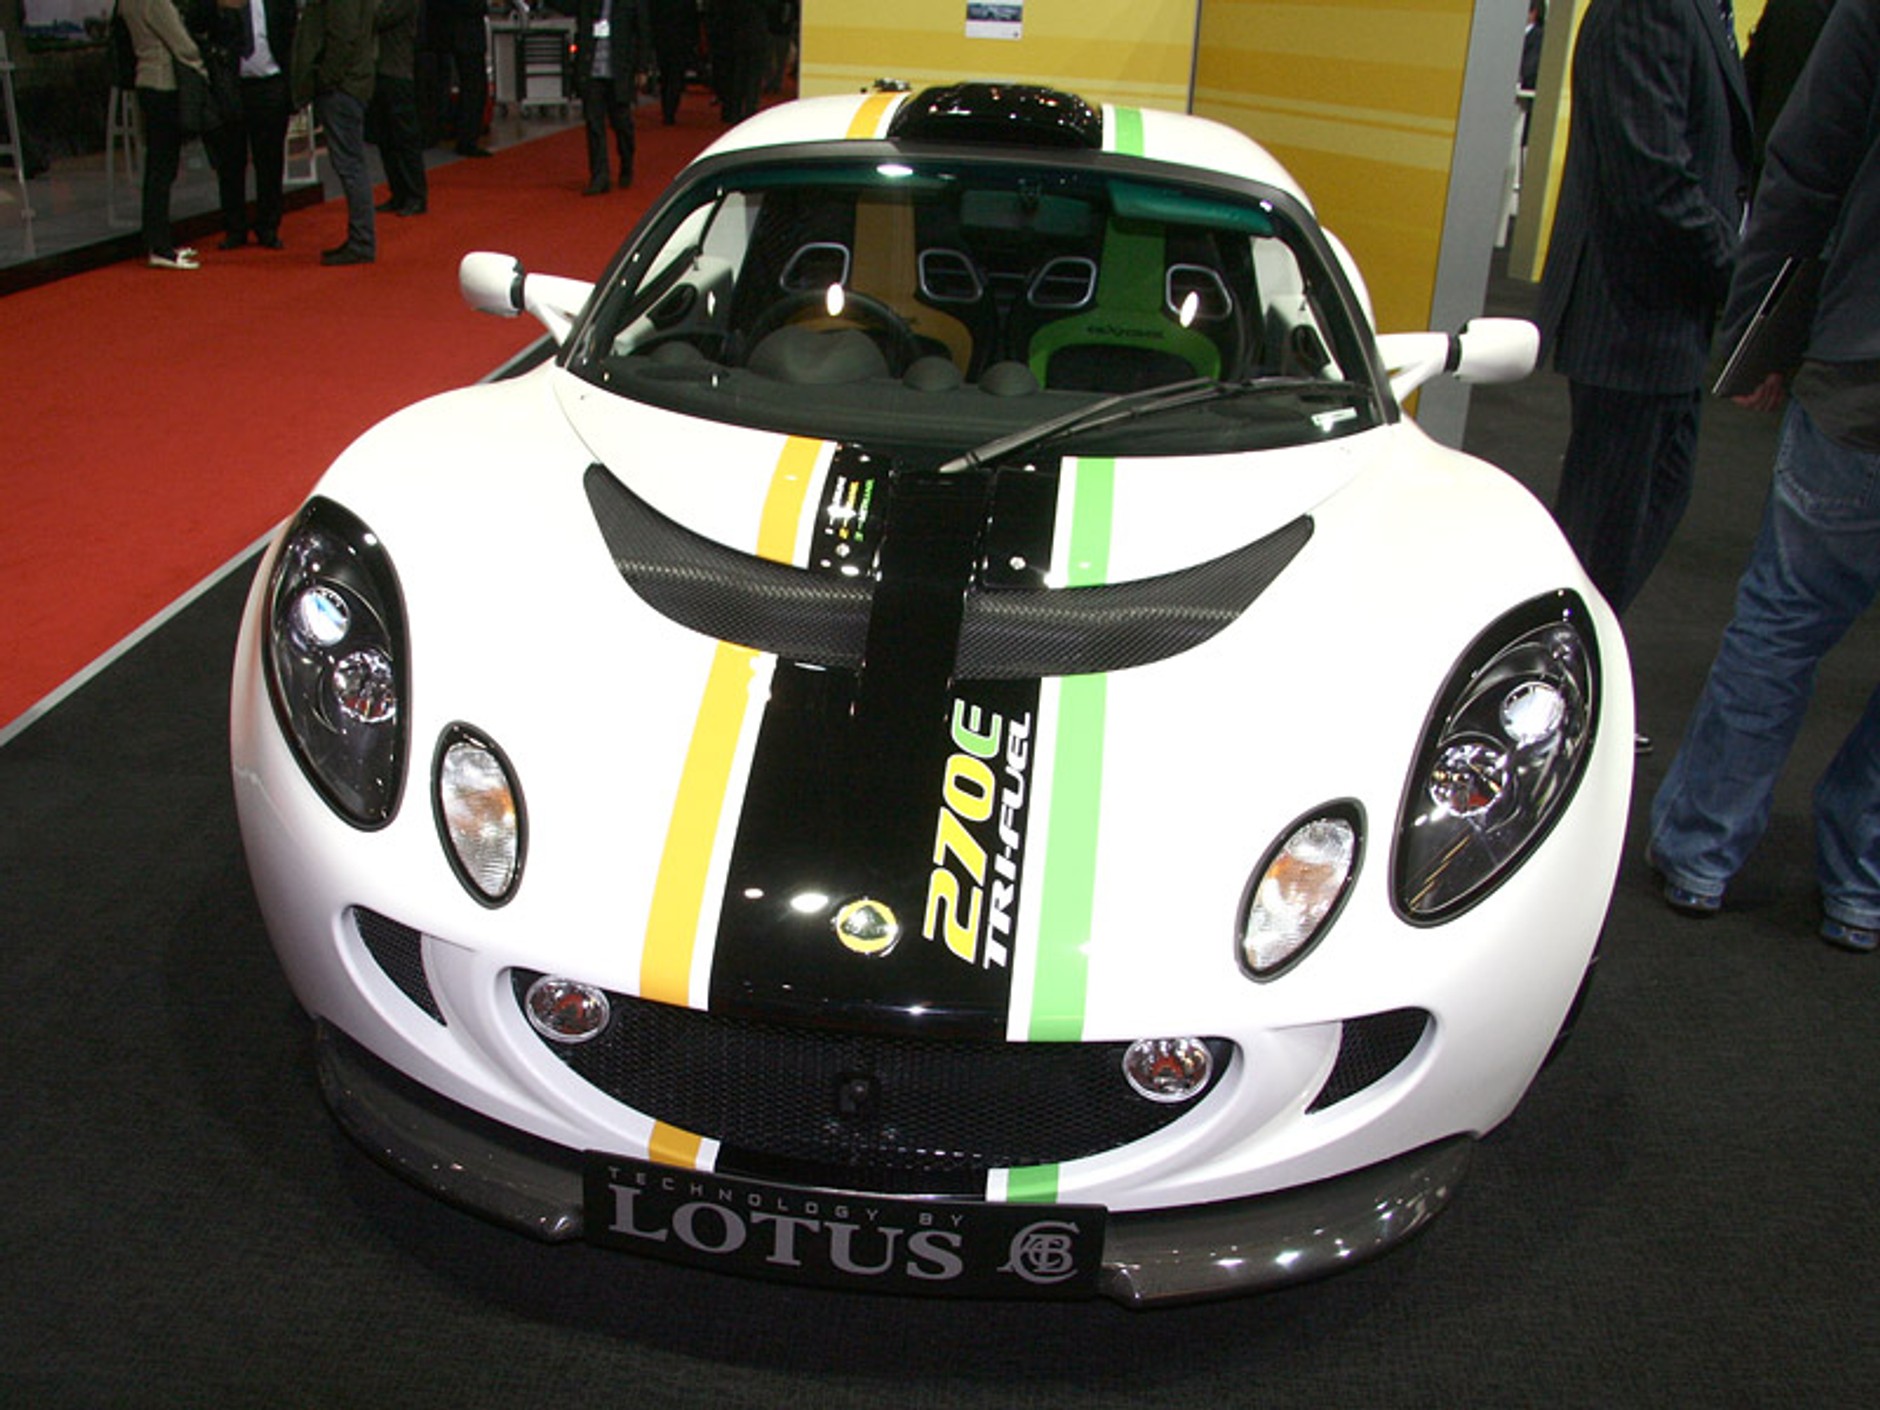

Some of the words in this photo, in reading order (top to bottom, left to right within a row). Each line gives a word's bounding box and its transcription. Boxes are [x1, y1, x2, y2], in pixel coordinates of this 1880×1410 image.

[983, 712, 1031, 969] TRI-FUEL
[608, 1166, 879, 1221] TECHNOLOGY
[918, 1212, 963, 1227] BY
[608, 1183, 963, 1280] LOTUS
